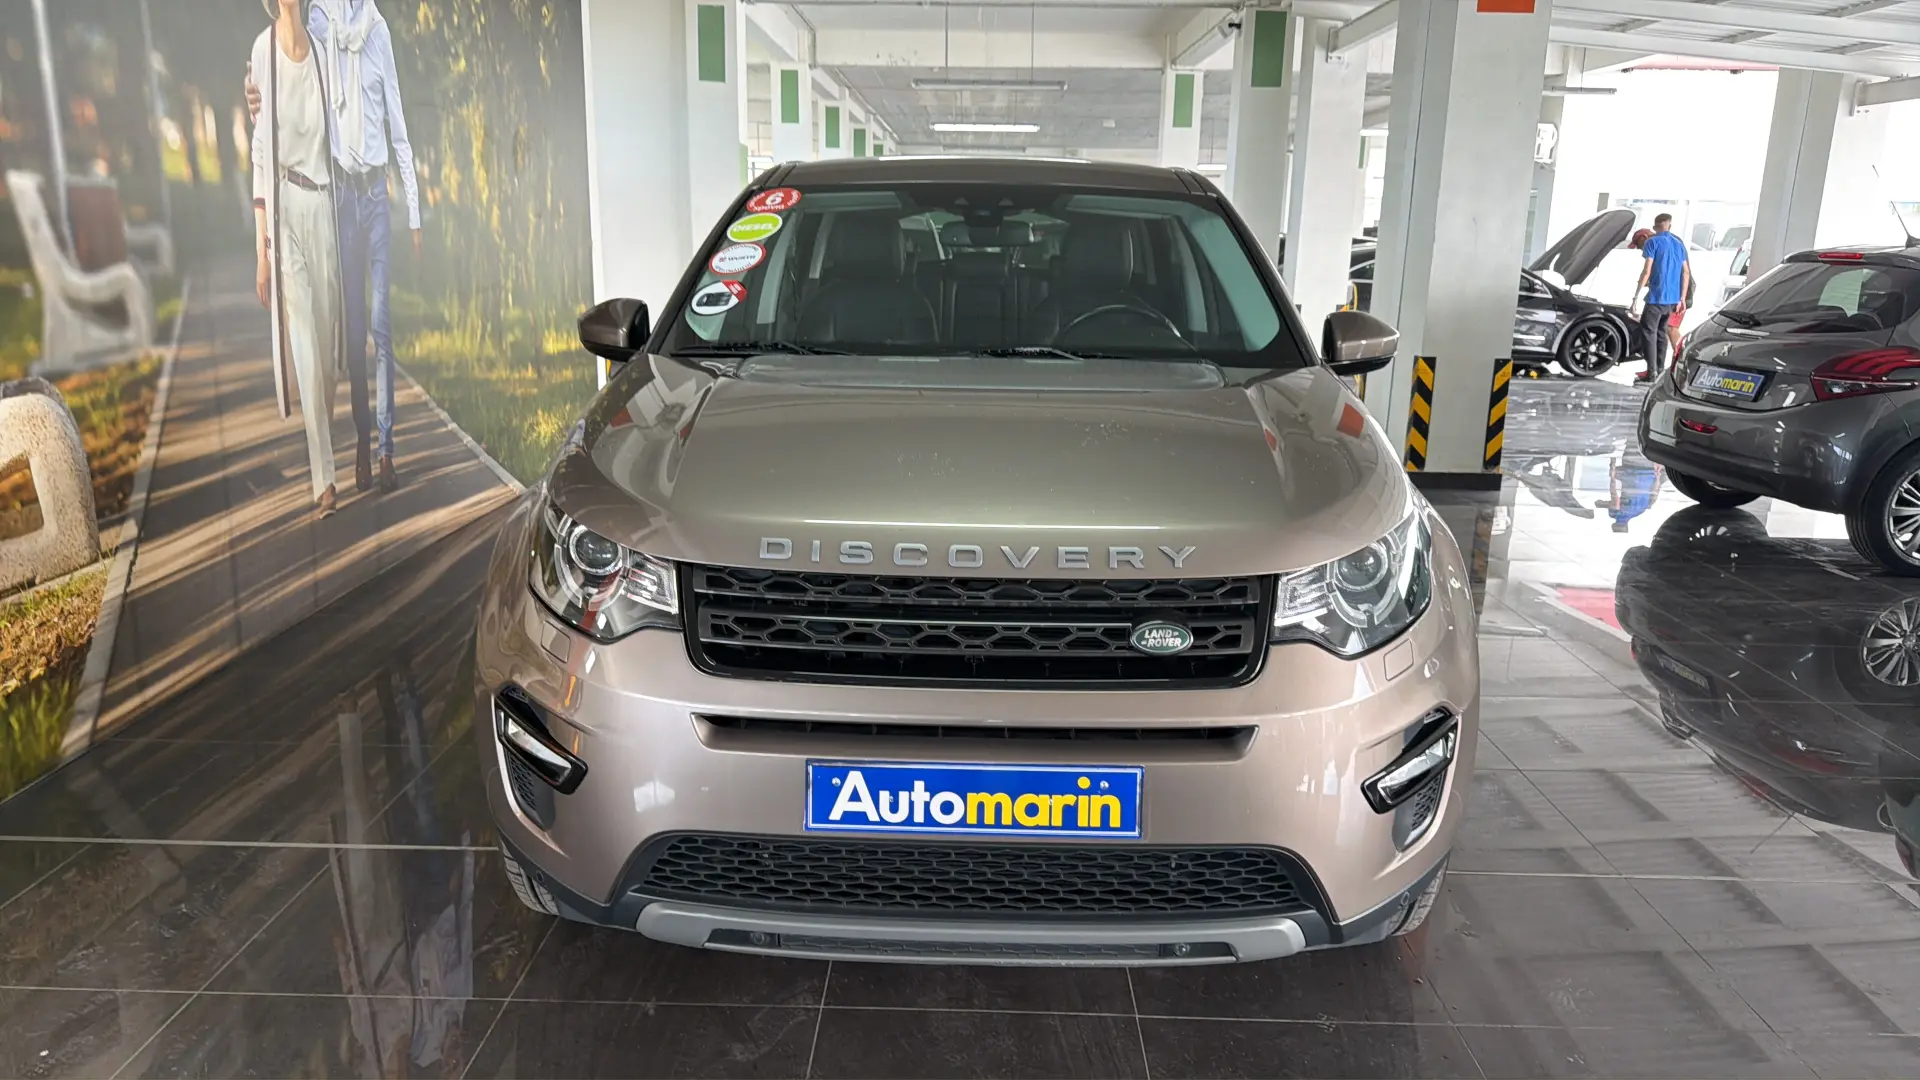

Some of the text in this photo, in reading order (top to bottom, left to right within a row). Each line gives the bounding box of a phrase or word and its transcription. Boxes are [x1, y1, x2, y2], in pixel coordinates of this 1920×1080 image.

[766, 191, 784, 205] 6
[732, 223, 772, 232] DIESEL
[1697, 369, 1755, 393] Automarin
[759, 537, 1196, 569] DISCOVERY
[828, 770, 1121, 828] Automarin
